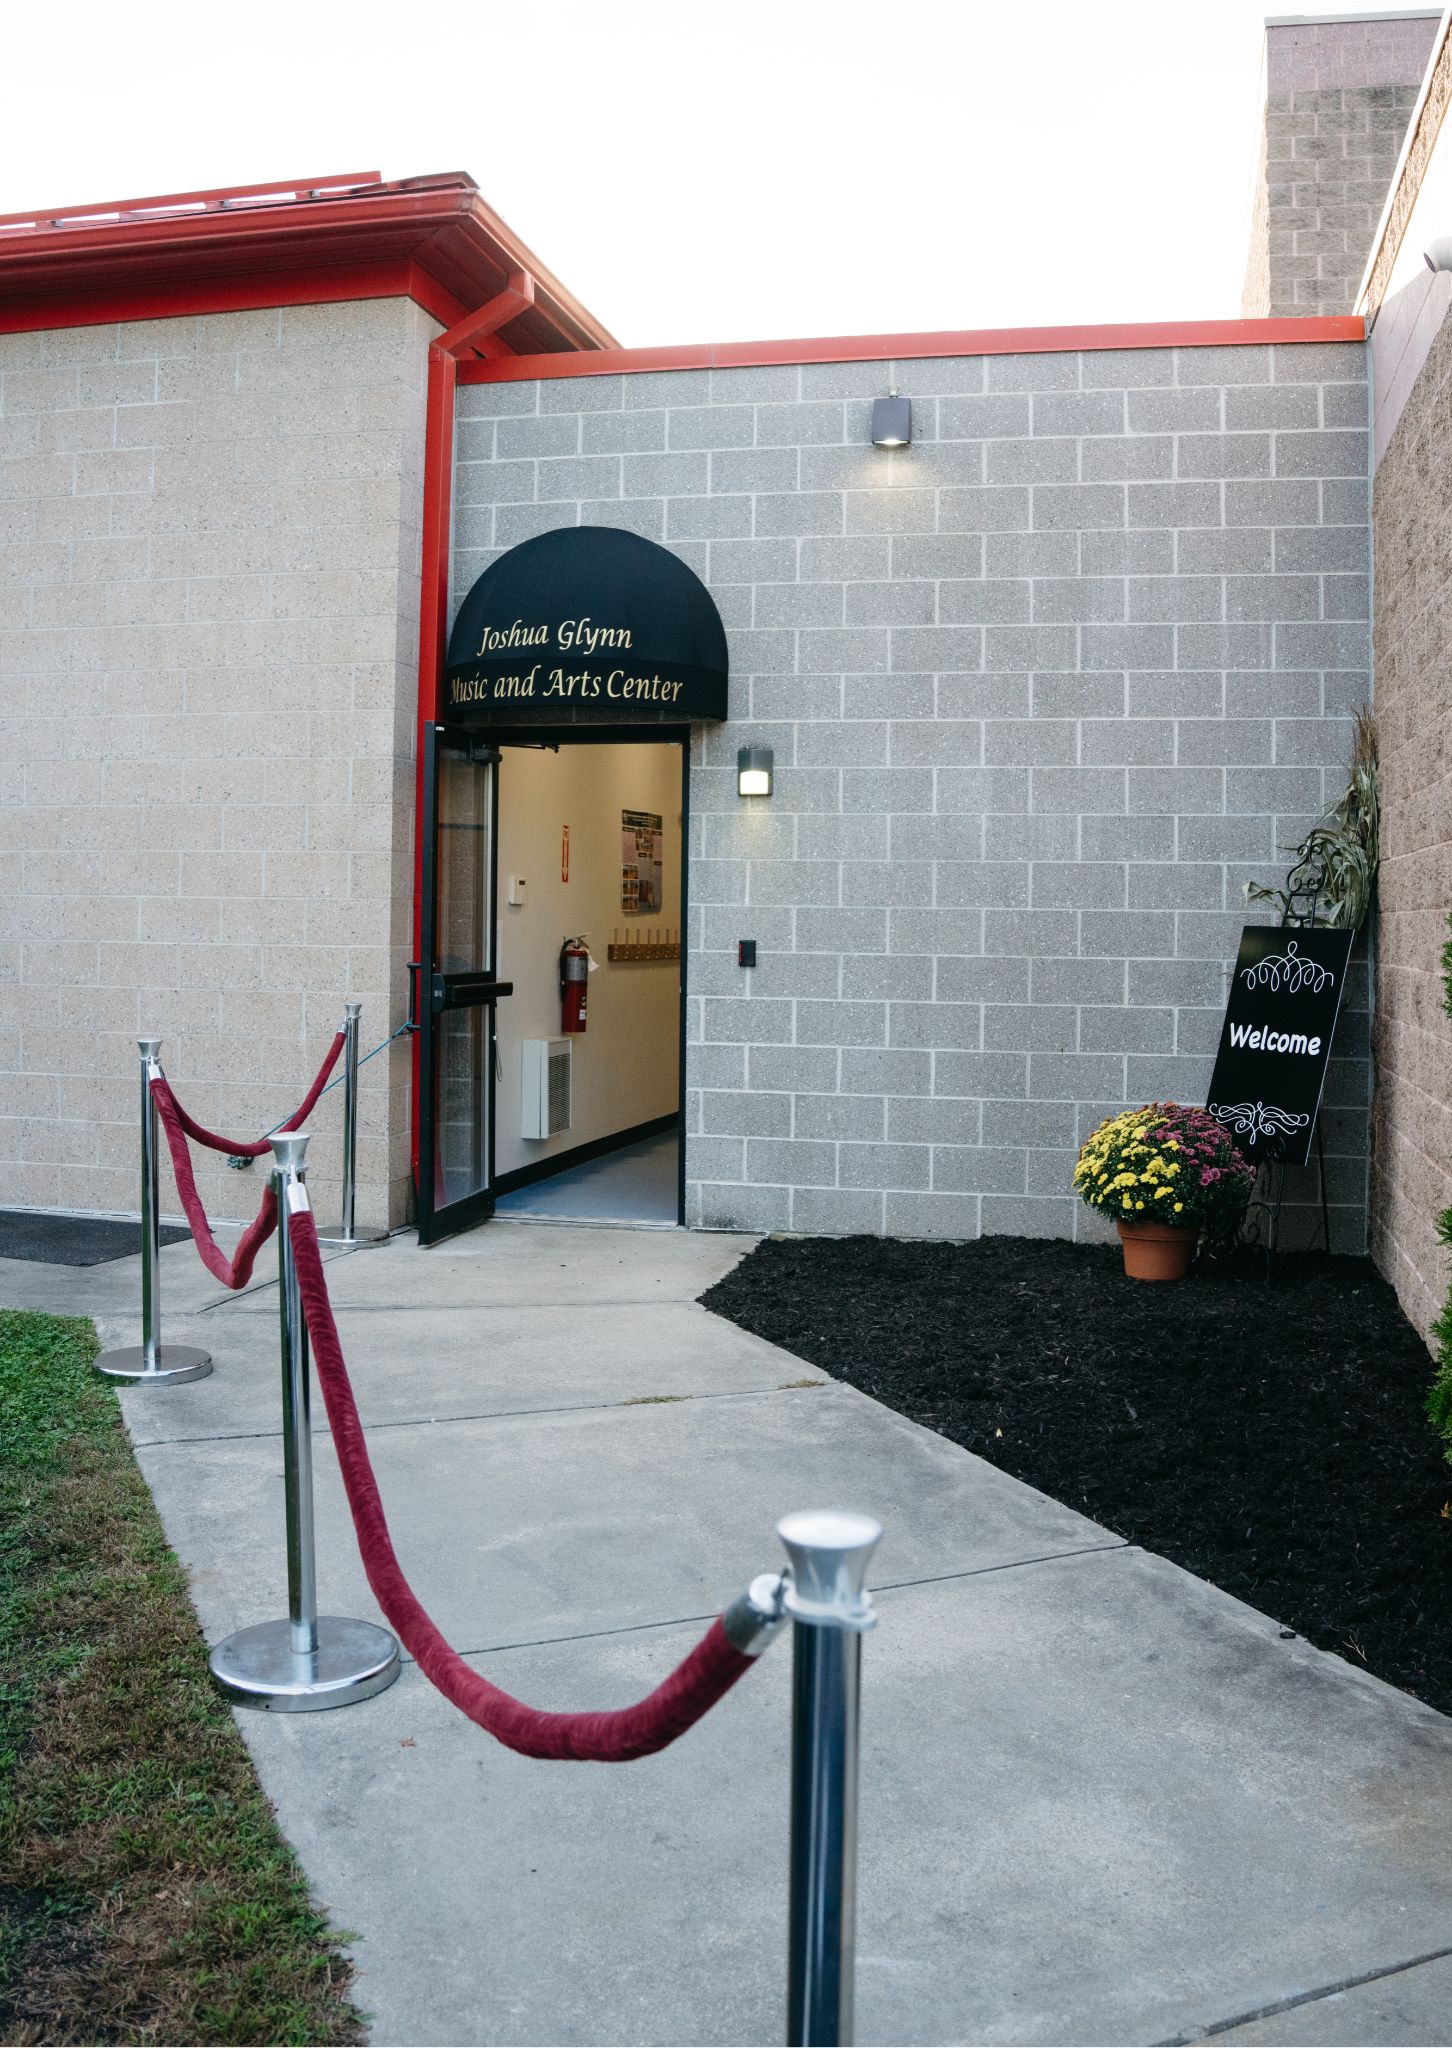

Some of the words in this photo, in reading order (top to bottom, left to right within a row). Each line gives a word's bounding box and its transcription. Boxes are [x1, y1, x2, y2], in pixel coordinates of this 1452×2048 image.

[476, 619, 549, 656] Joshua
[557, 617, 632, 655] Glynn
[450, 672, 488, 704] Music
[494, 665, 542, 697] and
[542, 668, 601, 697] Arts
[607, 669, 683, 702] Center
[1230, 1022, 1321, 1055] Welcome
